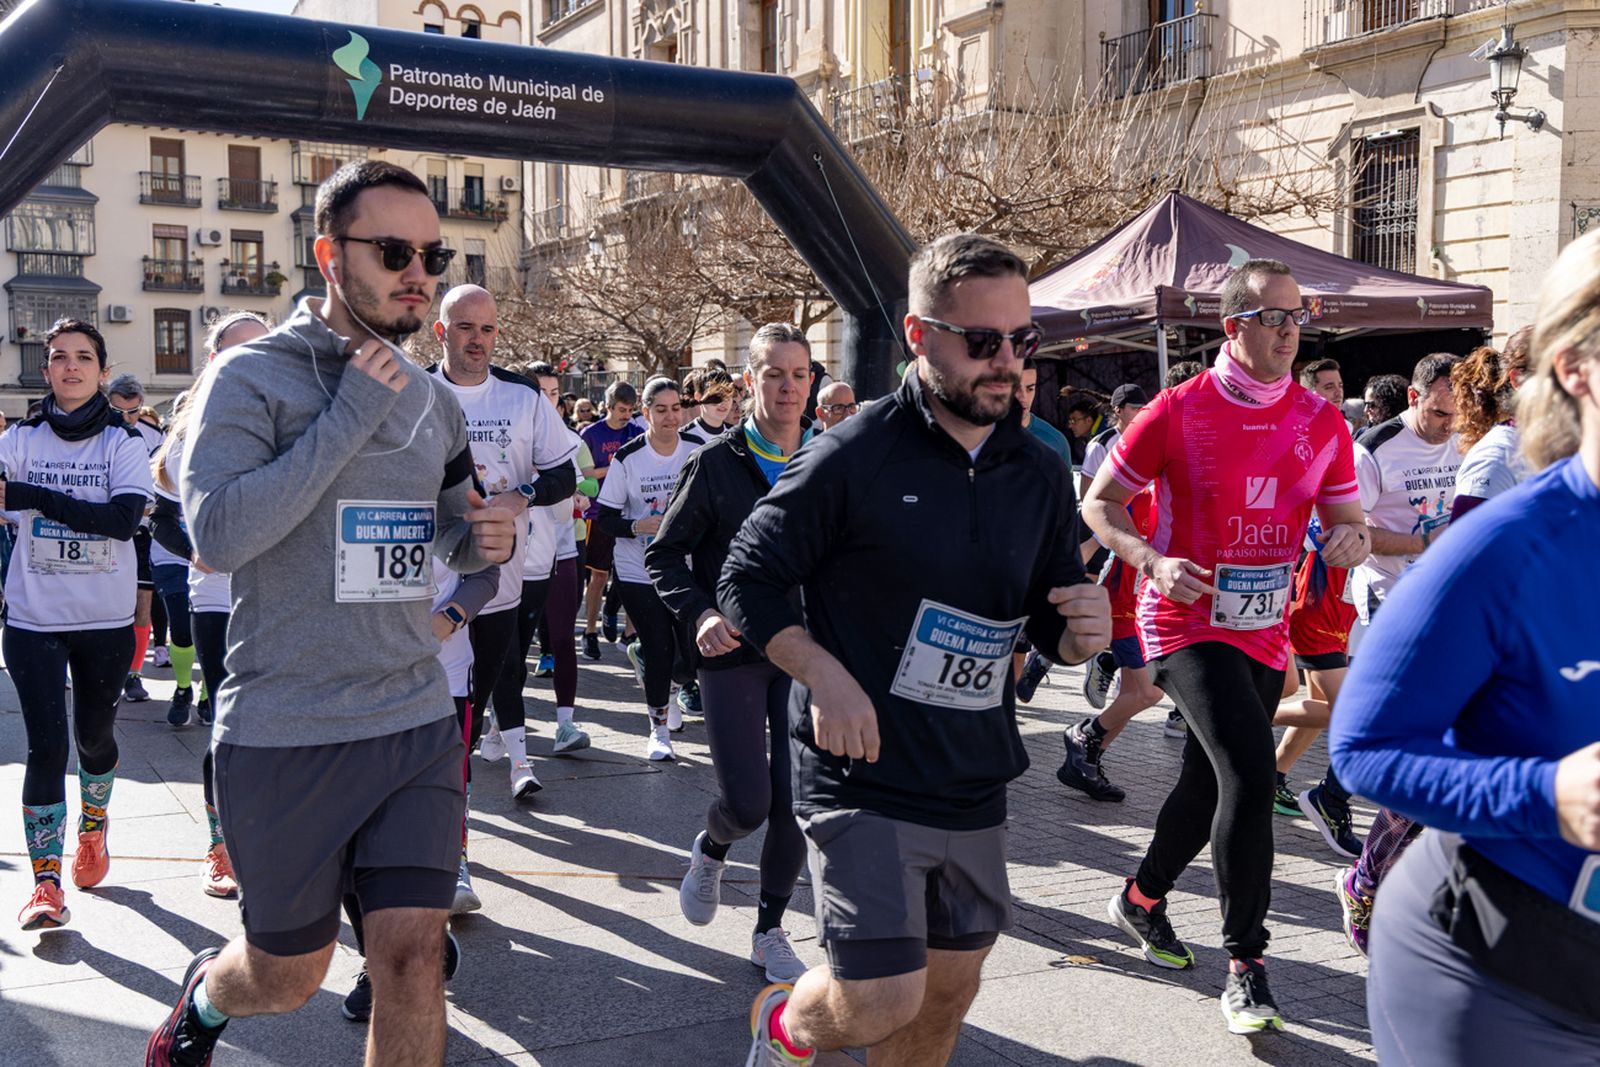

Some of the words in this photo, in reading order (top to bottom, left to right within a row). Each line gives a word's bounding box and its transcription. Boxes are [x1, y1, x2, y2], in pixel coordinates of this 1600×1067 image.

[390, 64, 484, 90] Patronato
[489, 74, 577, 102] Municipal
[582, 86, 604, 103] de
[389, 86, 478, 112] Deportes
[483, 97, 508, 115] de
[512, 100, 556, 120] Jaén
[466, 430, 494, 442] UERTE
[39, 460, 76, 470] CARRERA
[1412, 467, 1442, 476] CARRERA
[27, 471, 58, 483] BUENA
[61, 473, 101, 487] MUERTE
[1405, 478, 1433, 491] BUENA
[1434, 476, 1456, 488] MUER
[641, 483, 662, 492] BUENA
[356, 512, 366, 520] VI
[367, 512, 406, 521] CARRERA
[40, 528, 60, 537] BUENA
[356, 525, 390, 539] BUENA
[393, 525, 425, 539] MUERTE
[1228, 516, 1288, 547] Jaén
[58, 541, 81, 560] 18
[1216, 547, 1256, 558] PARAÍSO
[374, 544, 425, 579] 189
[1228, 580, 1251, 590] BUENA
[1253, 579, 1276, 590] MUERTE
[1238, 592, 1274, 616] 731
[937, 615, 947, 625] VI
[947, 618, 987, 638] CARRERA
[930, 628, 964, 651] BUENA
[966, 639, 1004, 656] MUERTE
[938, 653, 995, 690] 186
